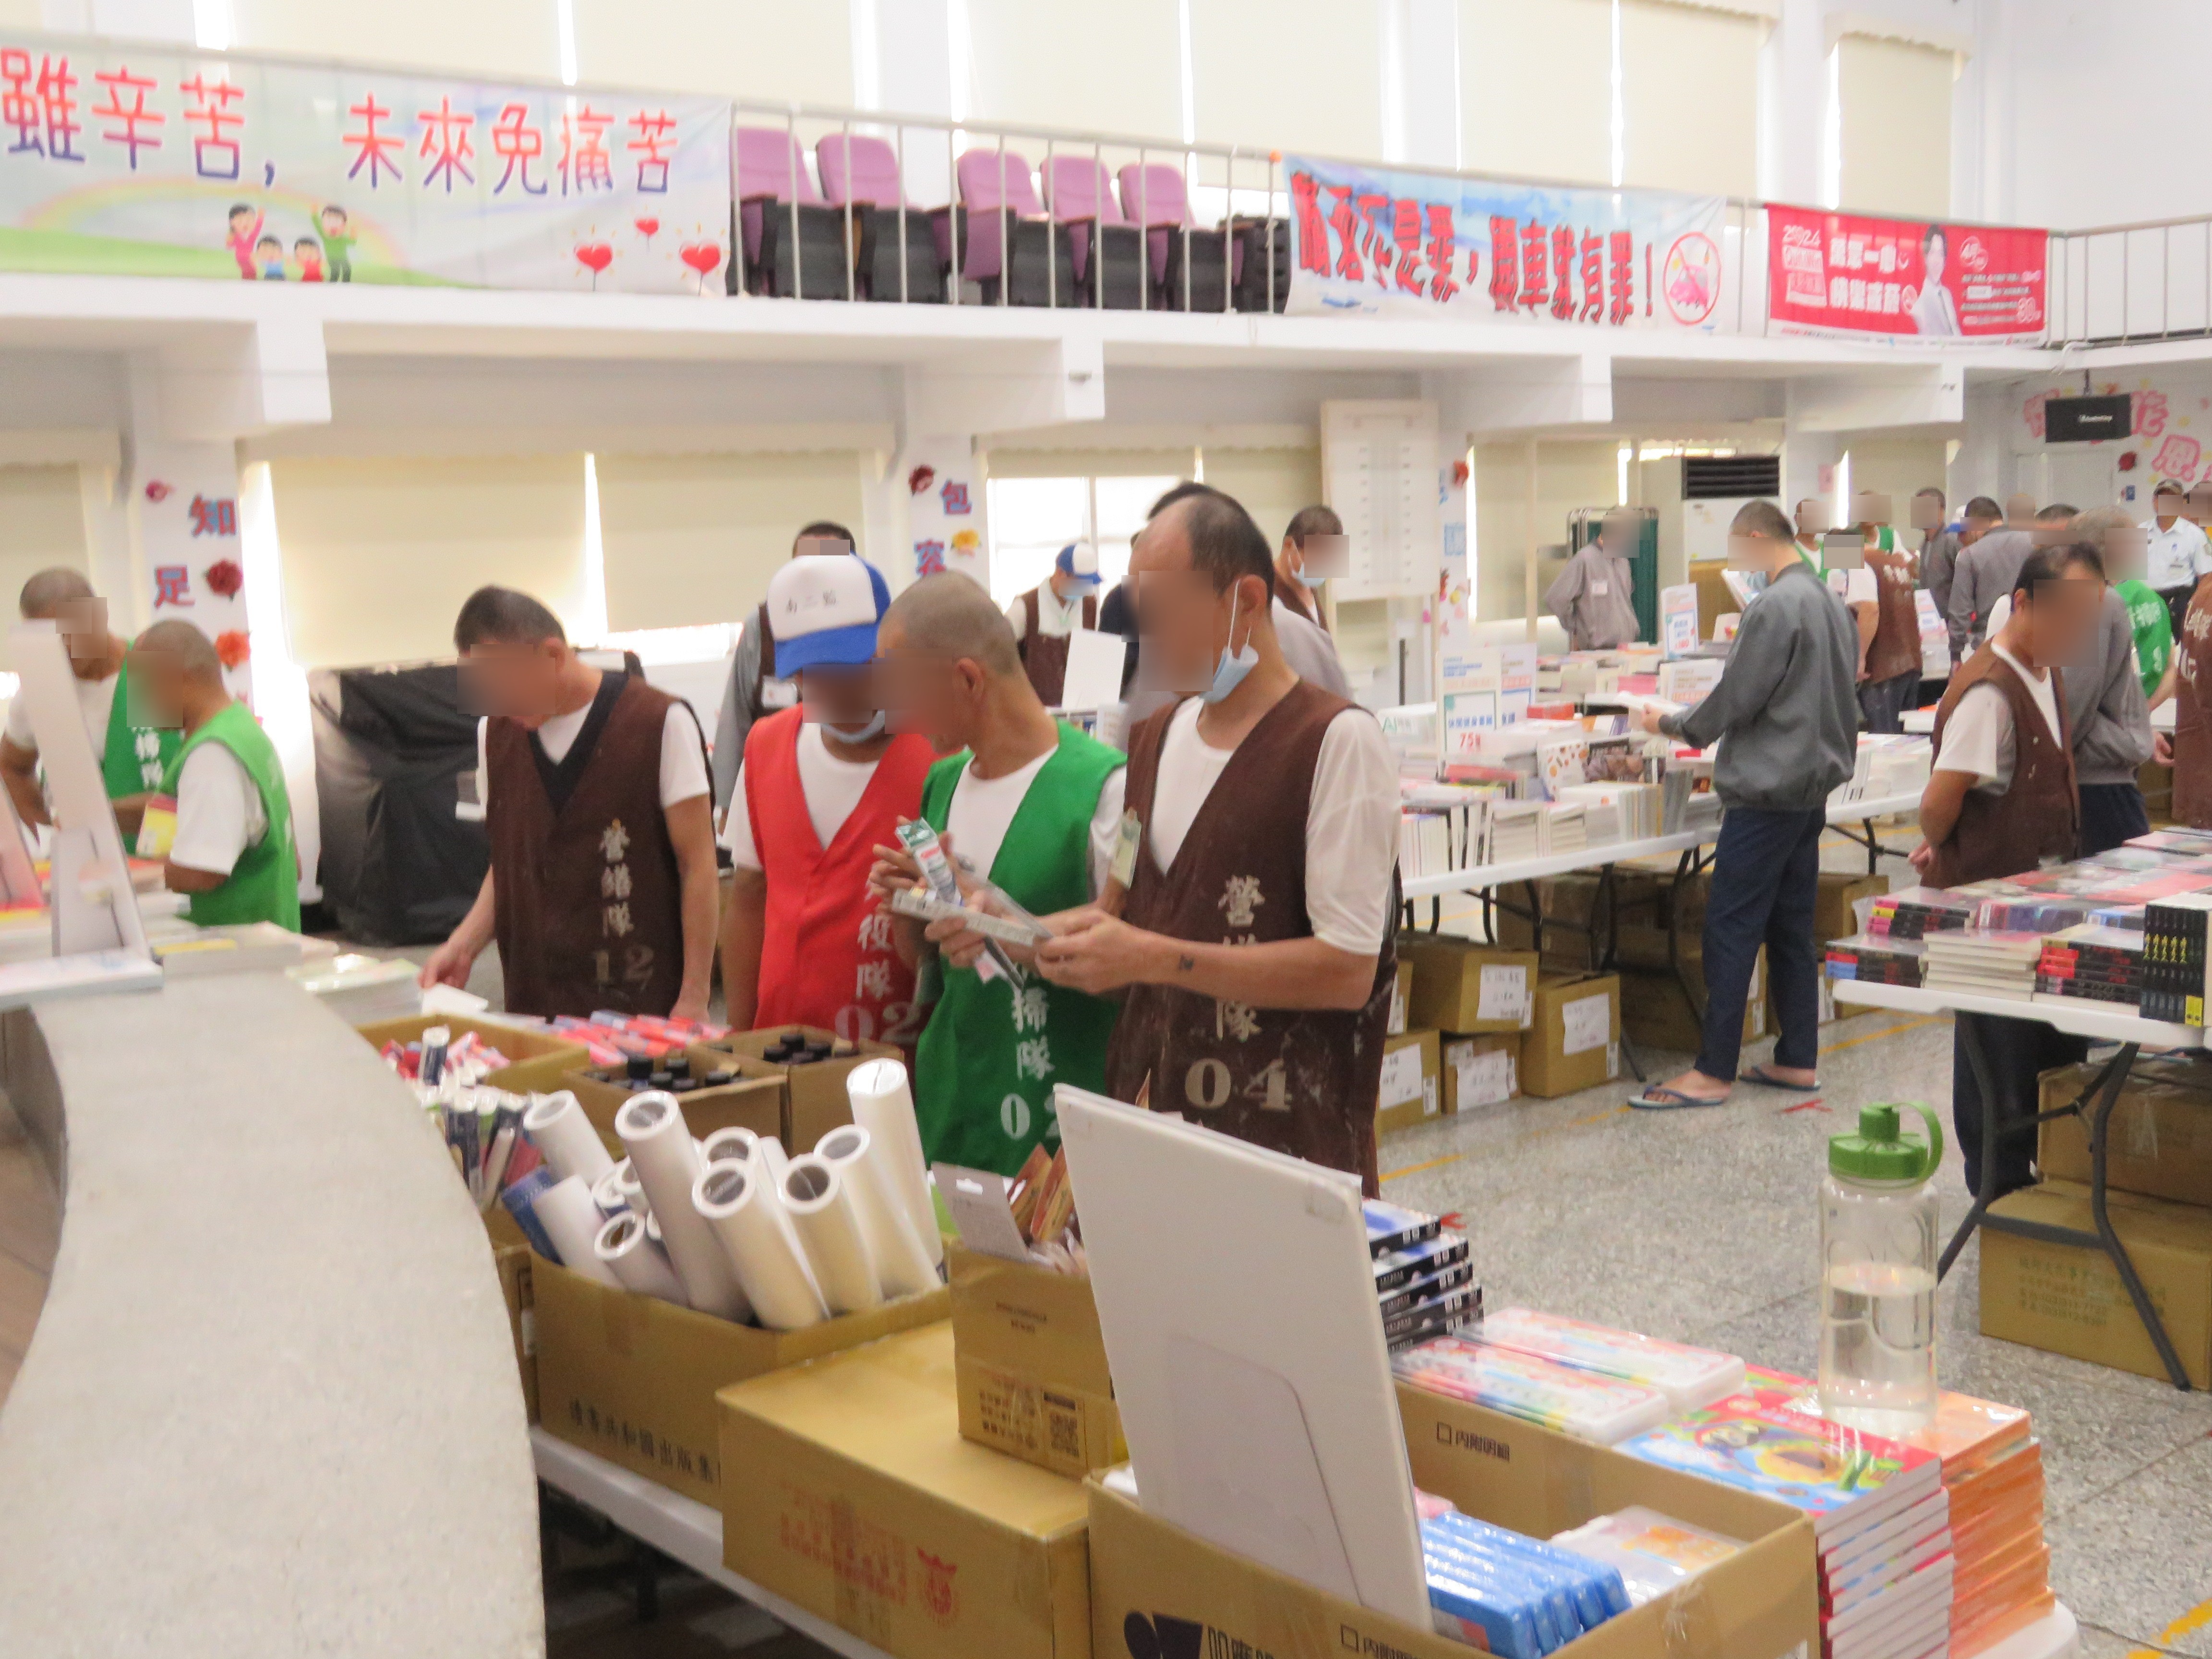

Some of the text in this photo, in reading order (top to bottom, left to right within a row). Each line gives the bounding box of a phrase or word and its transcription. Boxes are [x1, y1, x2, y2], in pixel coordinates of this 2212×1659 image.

[1214, 875, 1265, 1043] 營隊
[1011, 964, 1056, 1082] 掃隊
[1184, 1057, 1292, 1113] 04
